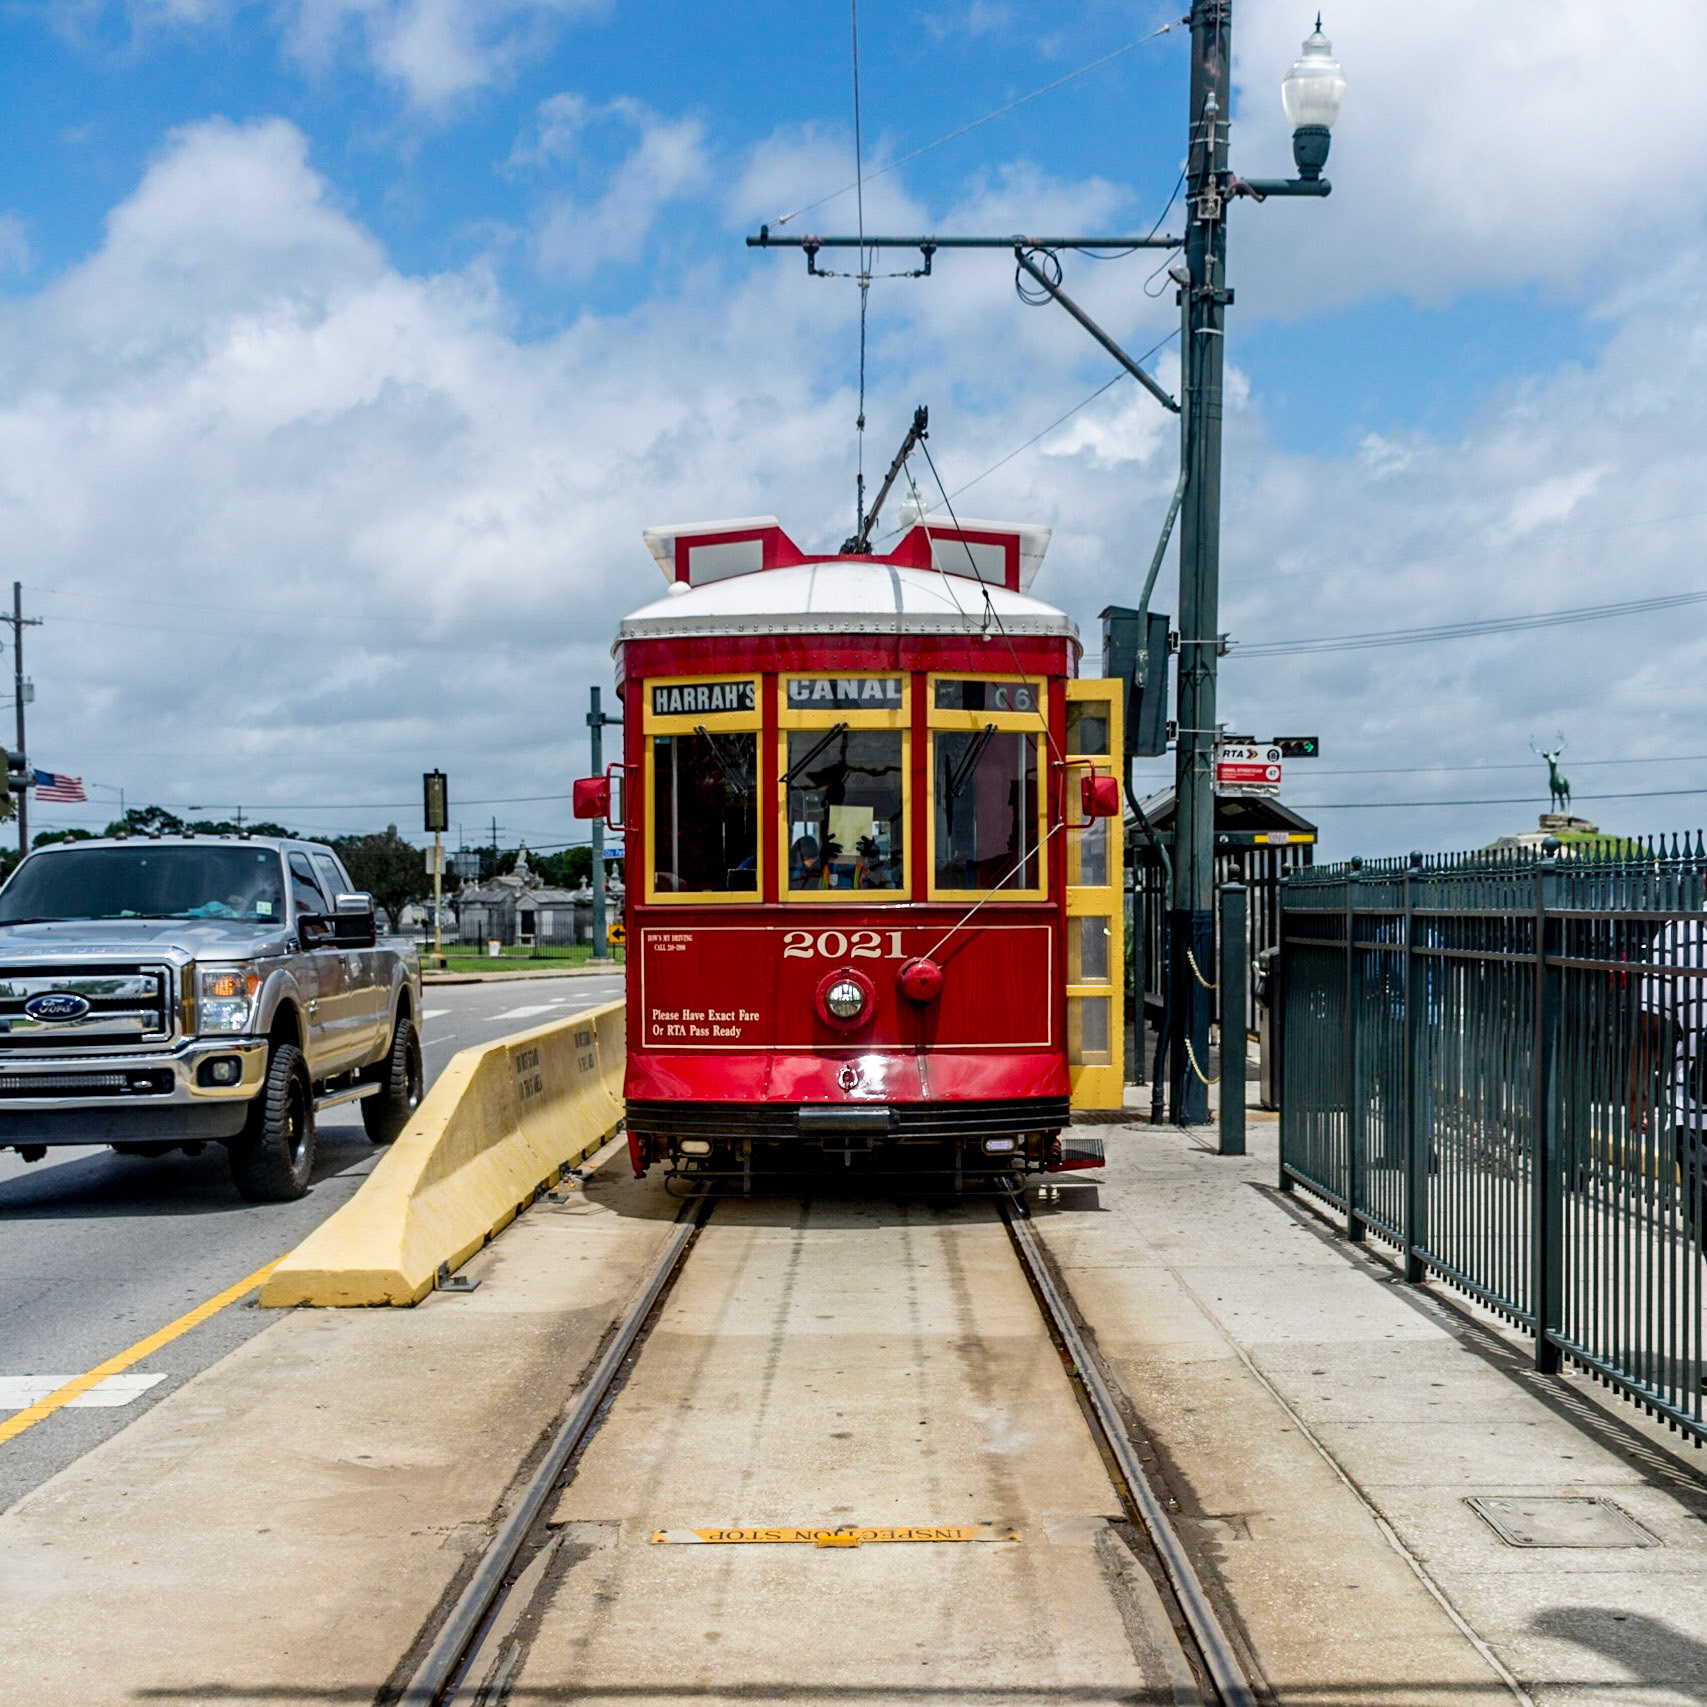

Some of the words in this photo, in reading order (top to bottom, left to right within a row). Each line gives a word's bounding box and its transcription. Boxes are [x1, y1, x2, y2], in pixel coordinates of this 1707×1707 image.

[788, 680, 902, 700] CANAL
[655, 683, 755, 713] HARRAH'S
[1223, 750, 1244, 758] RTA
[783, 931, 908, 958] 2021
[39, 999, 74, 1013] Ford
[652, 1009, 679, 1021] Please
[682, 1009, 705, 1021] Have
[708, 1009, 735, 1021] Exact
[739, 1009, 760, 1021] Fare
[652, 1024, 664, 1036] Or
[667, 1025, 686, 1036] RTA
[689, 1025, 709, 1036] Pass
[713, 1025, 741, 1038] Ready
[708, 1530, 781, 1541] STOP
